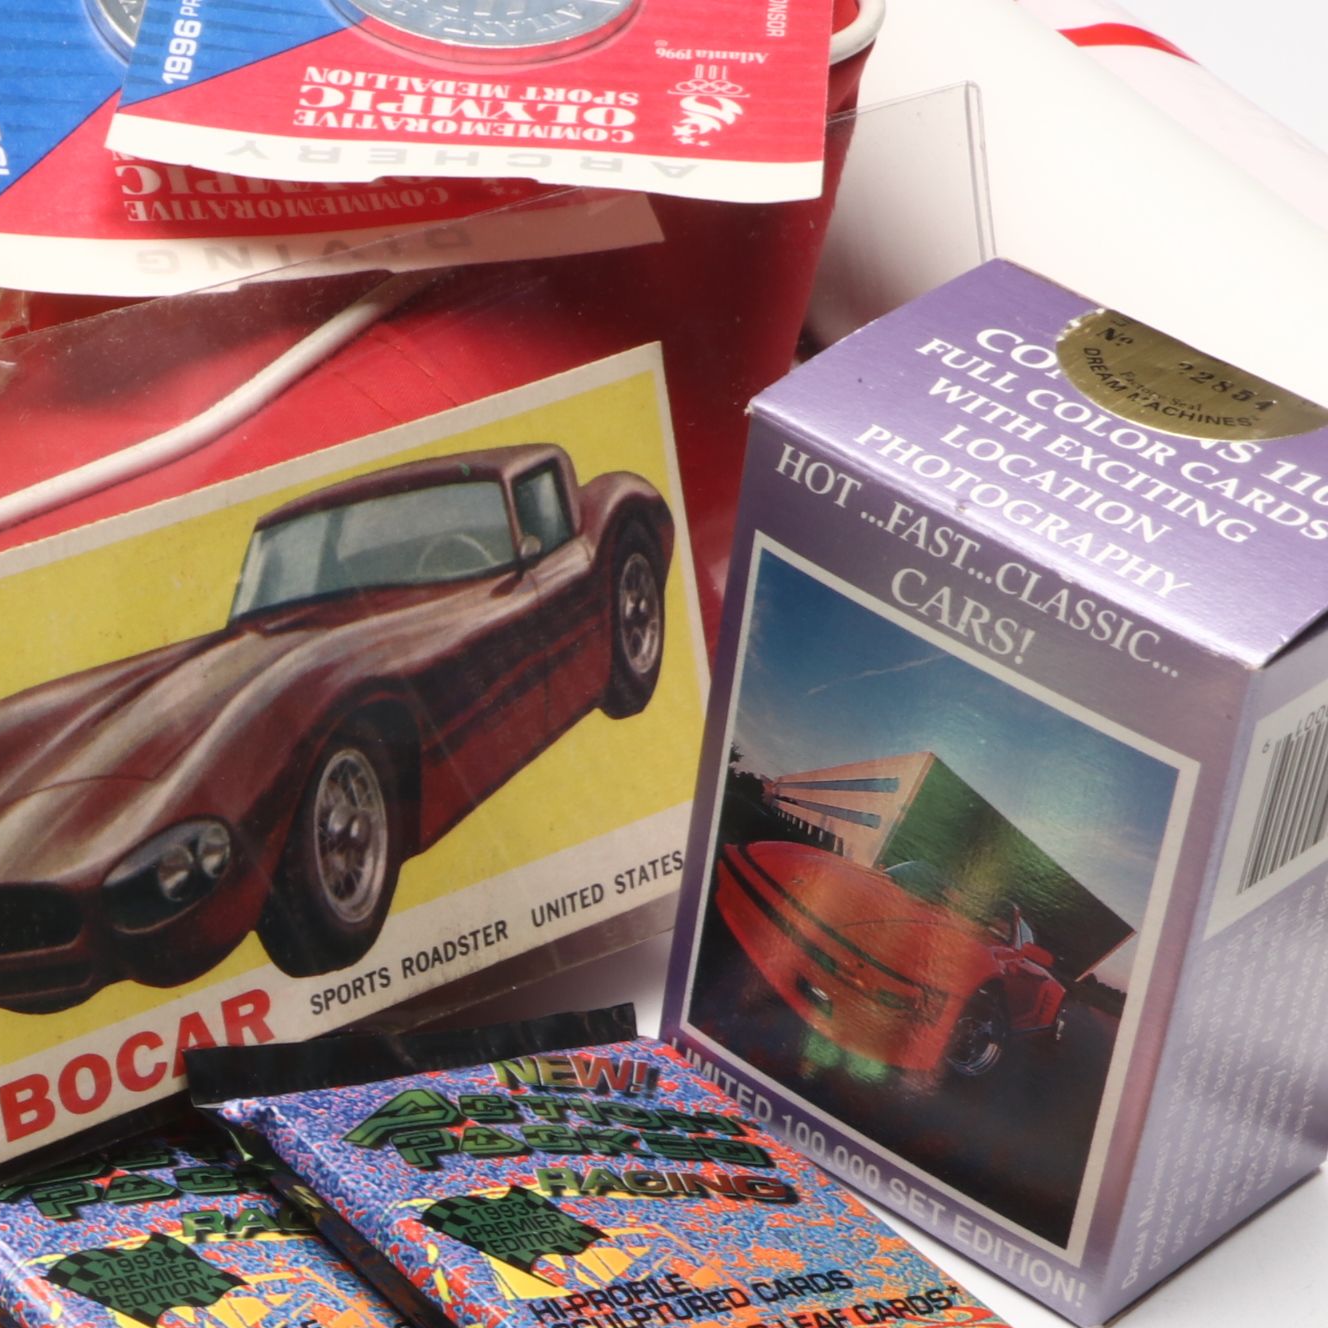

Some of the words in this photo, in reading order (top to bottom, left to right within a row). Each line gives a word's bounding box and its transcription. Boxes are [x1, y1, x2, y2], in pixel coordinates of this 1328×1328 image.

[162, 19, 202, 84] 1996
[655, 46, 691, 60] 1996
[695, 49, 771, 65] Atlanta
[303, 66, 510, 100] MEDALLION
[520, 86, 640, 107] SPORT
[291, 109, 635, 143] COMMEMORATIVE
[298, 84, 637, 128] OLYMPIC
[226, 139, 700, 179] ARCHERY
[124, 186, 449, 222] COMMEMORATIVE
[1084, 347, 1128, 393] DREAM
[915, 338, 1017, 395] FULL
[1026, 385, 1178, 467] COLOR
[1180, 460, 1328, 540] CARDS
[774, 443, 862, 510] HOT
[927, 377, 1046, 445] WITH
[1049, 433, 1259, 543] EXCITING
[940, 425, 1173, 545] LOCATION
[853, 424, 1194, 599] PHOTOGRAPHY
[889, 567, 1038, 666] CARS!
[310, 965, 392, 1016] SPORTS
[401, 919, 509, 979] ROADSTER
[531, 880, 604, 928] UNITED
[614, 850, 684, 894] STATES
[490, 1055, 650, 1095] NEW!
[343, 1088, 746, 1149] ACTION
[388, 1123, 775, 1170] PACKED
[534, 1166, 792, 1203] RACING
[464, 1211, 566, 1241] PREMIER
[472, 1197, 529, 1221] 1993
[491, 1229, 573, 1255] EDITION
[886, 1175, 948, 1230] SET
[953, 1213, 1088, 1310] EDITION!
[95, 1261, 204, 1298] PREMIER
[101, 1252, 165, 1278] 1993
[121, 1278, 212, 1310] EDITION
[754, 1268, 854, 1303] CARDS
